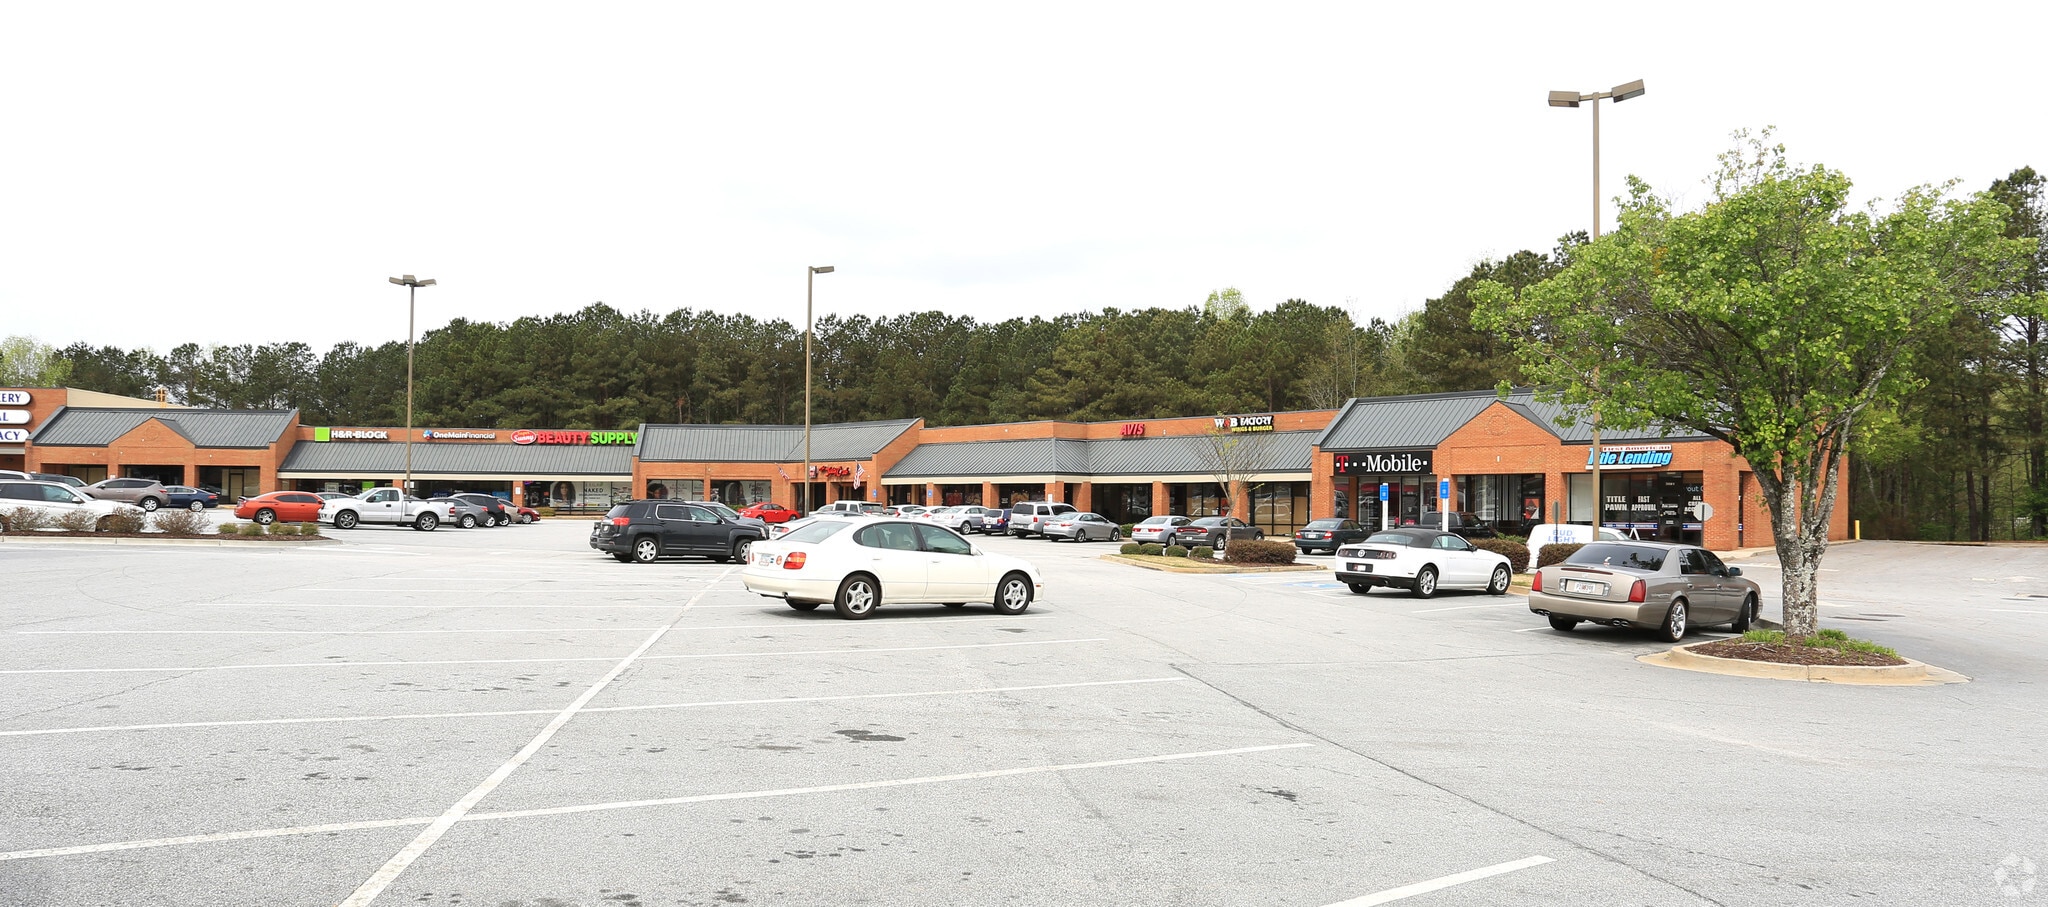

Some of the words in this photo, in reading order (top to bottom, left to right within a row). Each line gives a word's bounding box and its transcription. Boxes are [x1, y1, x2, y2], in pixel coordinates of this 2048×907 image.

[0, 393, 21, 403] ERY
[1240, 416, 1272, 426] FACTORY
[1120, 423, 1145, 435] AVIS
[537, 431, 589, 444] BEAUTY
[590, 431, 638, 445] SUPPLY
[1587, 447, 1617, 465] Ttle
[1618, 450, 1673, 465] Lending
[1606, 495, 1626, 503] TITLE
[1637, 495, 1650, 503] FAST
[1605, 503, 1628, 511] PAWN
[1631, 503, 1657, 511] APPROVAL
